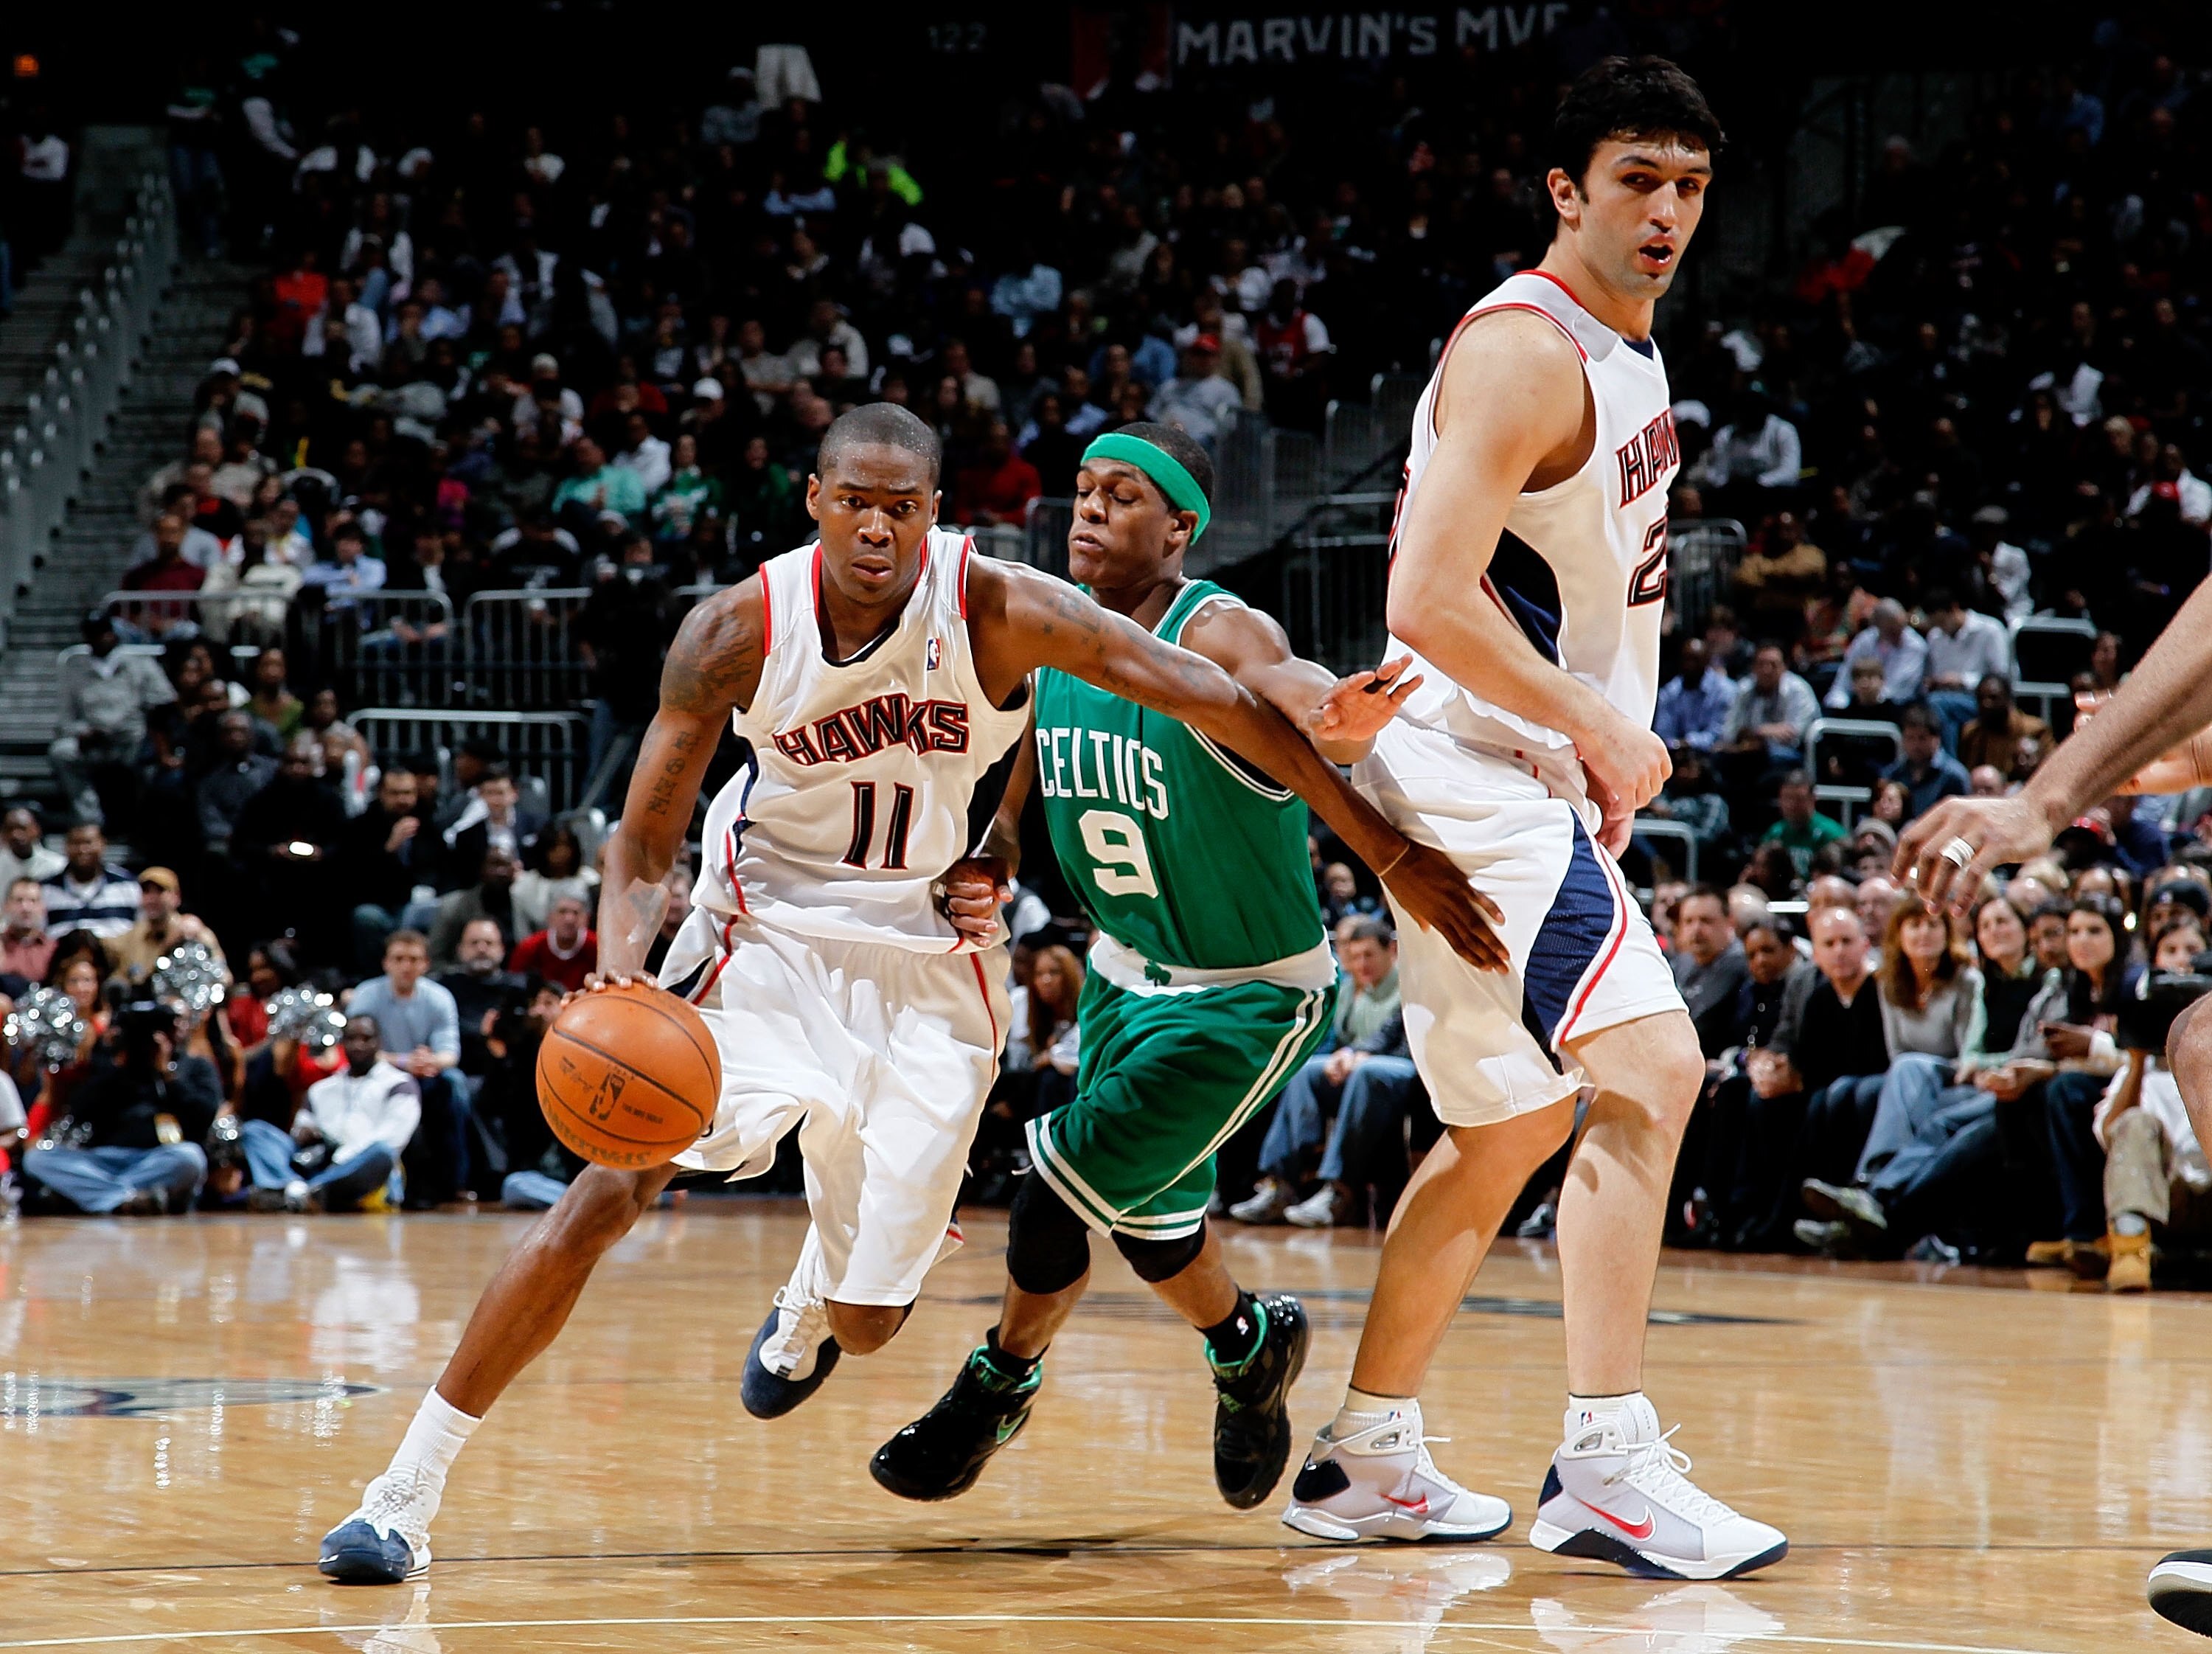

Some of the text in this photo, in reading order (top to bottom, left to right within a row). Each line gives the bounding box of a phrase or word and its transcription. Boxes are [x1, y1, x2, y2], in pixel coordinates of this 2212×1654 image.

[926, 21, 989, 52] 122
[1178, 10, 1439, 68] MARVIN'S
[1627, 516, 1668, 607] 2
[773, 692, 970, 766] HAWKS
[1034, 726, 1169, 820] CELTICS
[841, 782, 914, 869] 11
[1078, 809, 1159, 899] 9
